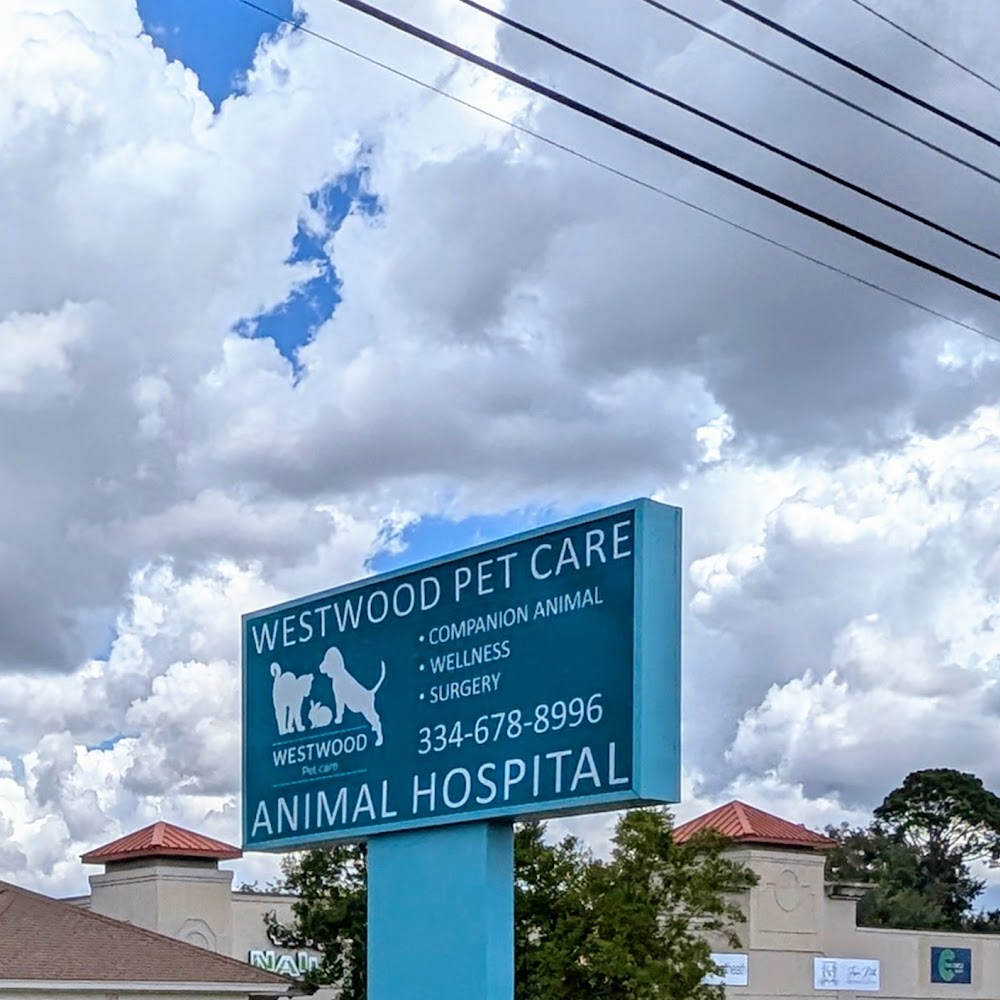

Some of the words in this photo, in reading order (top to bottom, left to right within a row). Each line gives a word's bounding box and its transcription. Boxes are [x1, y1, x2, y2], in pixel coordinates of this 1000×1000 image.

[252, 576, 441, 654] WESTWOOD
[455, 552, 518, 602] PET
[530, 520, 631, 580] CARE
[429, 604, 528, 645] COMPANION
[533, 586, 603, 620] ANIMAL
[430, 640, 511, 674] WELLNESS
[429, 672, 501, 704] SURGERY
[273, 734, 368, 767] WESTWOOD
[418, 693, 603, 754] 334-678-8996
[252, 780, 398, 838] ANIMAL
[412, 742, 629, 814] HOSPITAL
